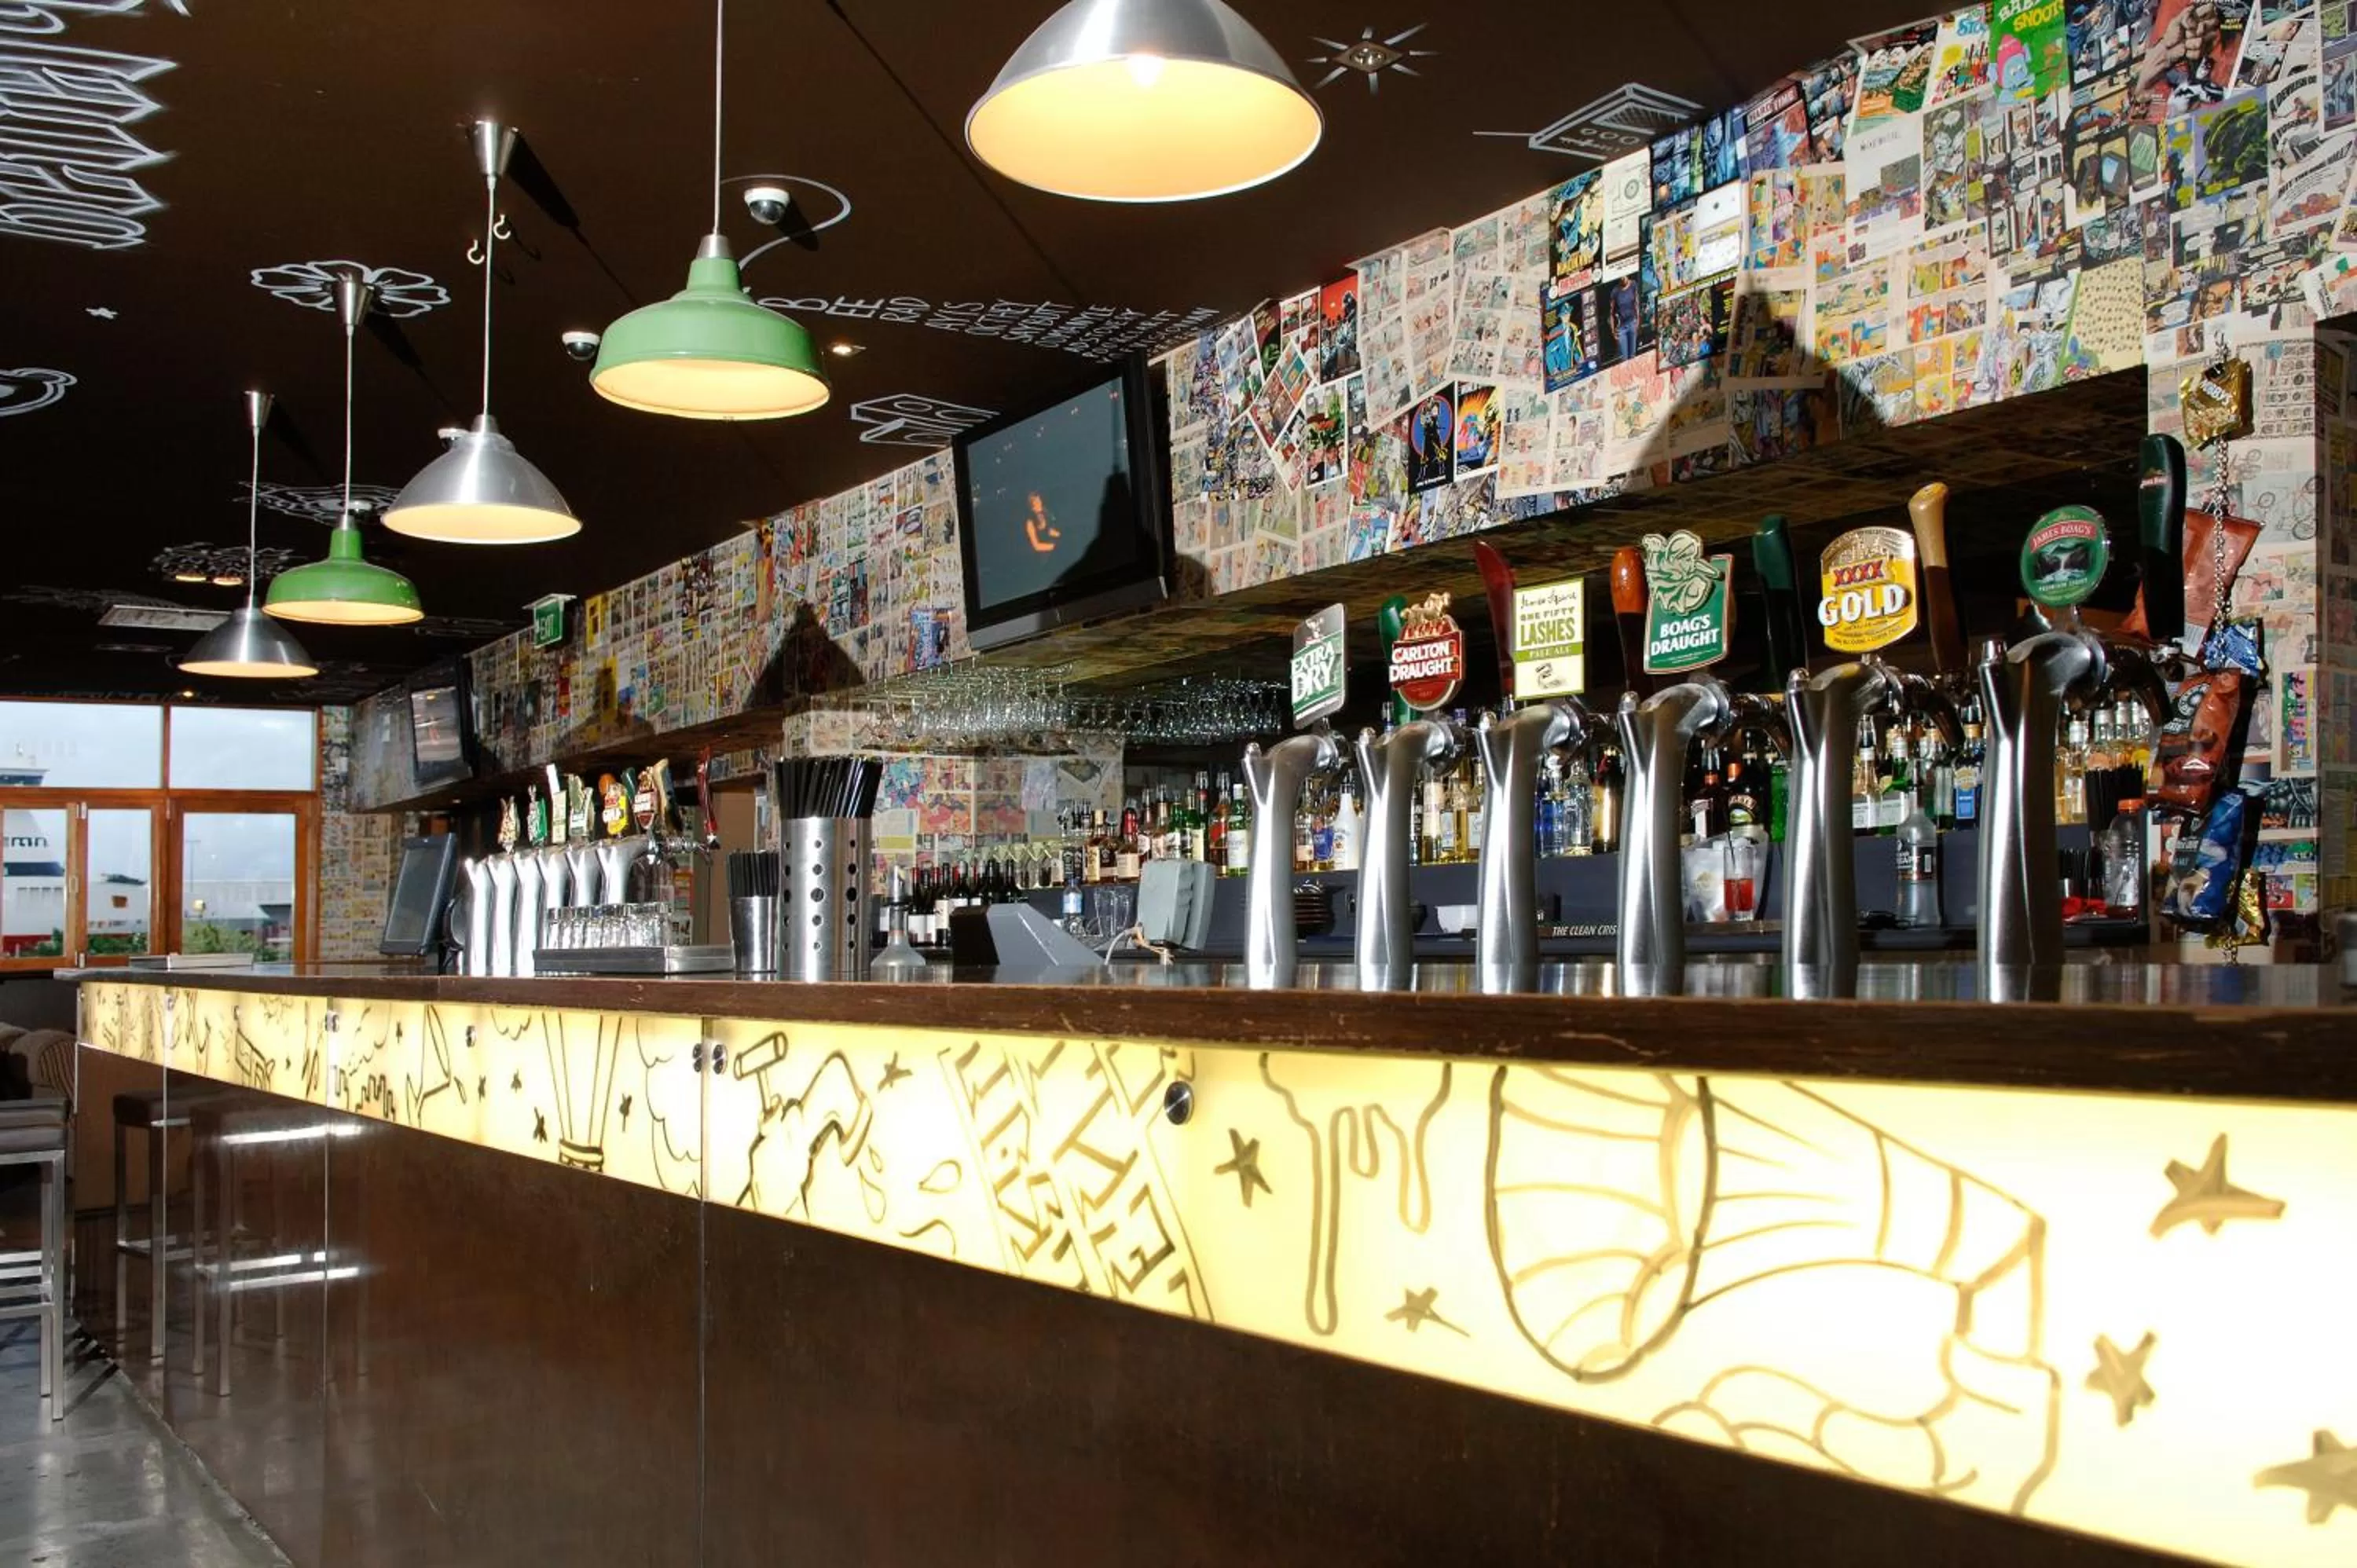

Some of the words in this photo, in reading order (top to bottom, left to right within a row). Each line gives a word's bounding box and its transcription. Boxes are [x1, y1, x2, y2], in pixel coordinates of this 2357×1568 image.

[2032, 526, 2059, 548] JAMES
[2061, 523, 2093, 537] BOAG'S
[1834, 559, 1885, 587] XXXX
[1520, 611, 1541, 621] ONE
[1543, 606, 1575, 618] FIFTY
[1817, 584, 1906, 626] GOLD
[1520, 617, 1575, 647] LASHES
[1660, 614, 1711, 639] BOAG'S
[1391, 640, 1450, 664] CARLTON
[1529, 647, 1552, 659] PALE
[1651, 628, 1720, 657] DRAUGHT
[1291, 641, 1335, 674] EXTRA
[1291, 658, 1335, 703] DRY
[1388, 658, 1453, 683] DRAUGHT
[1552, 926, 1570, 936] THE
[1569, 925, 1598, 936] CLEAN
[1597, 925, 1617, 936] CRIS
